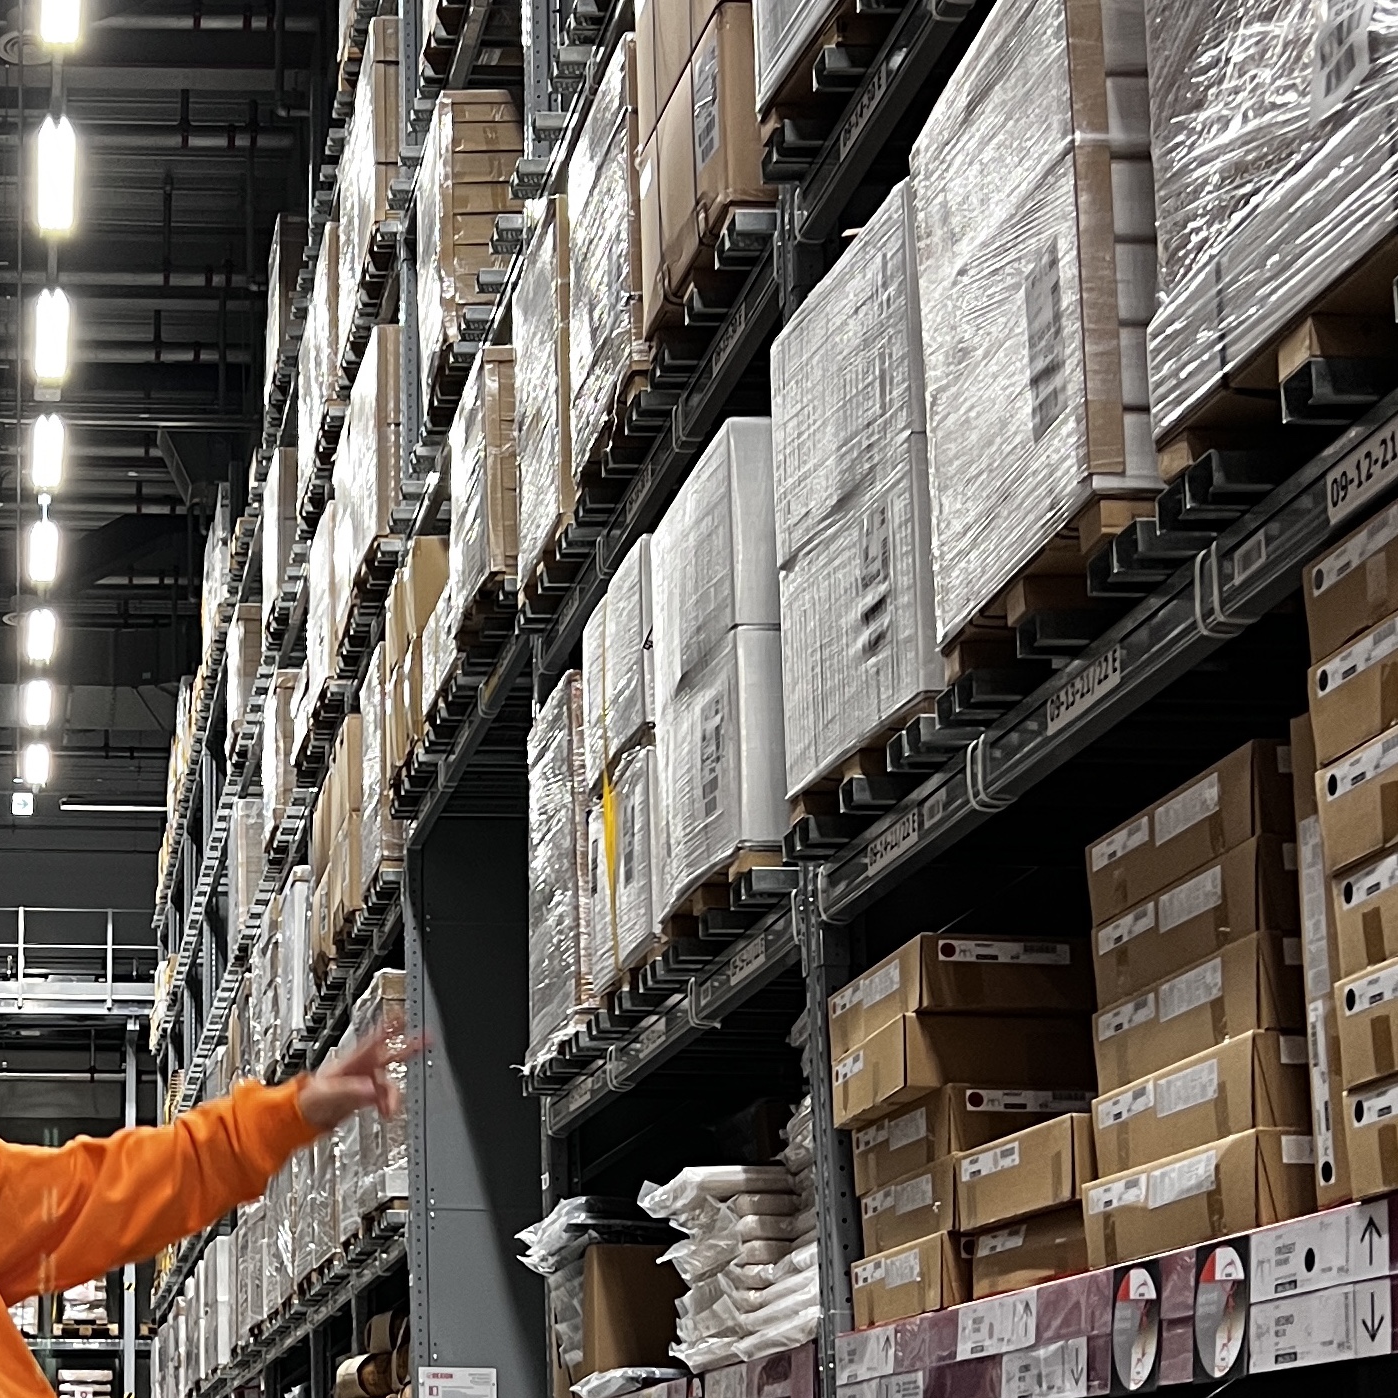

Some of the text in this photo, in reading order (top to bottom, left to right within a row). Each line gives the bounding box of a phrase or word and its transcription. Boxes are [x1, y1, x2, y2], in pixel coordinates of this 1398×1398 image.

[1330, 430, 1398, 508] 09-12-21
[1112, 647, 1119, 674] E
[912, 811, 917, 834] E
